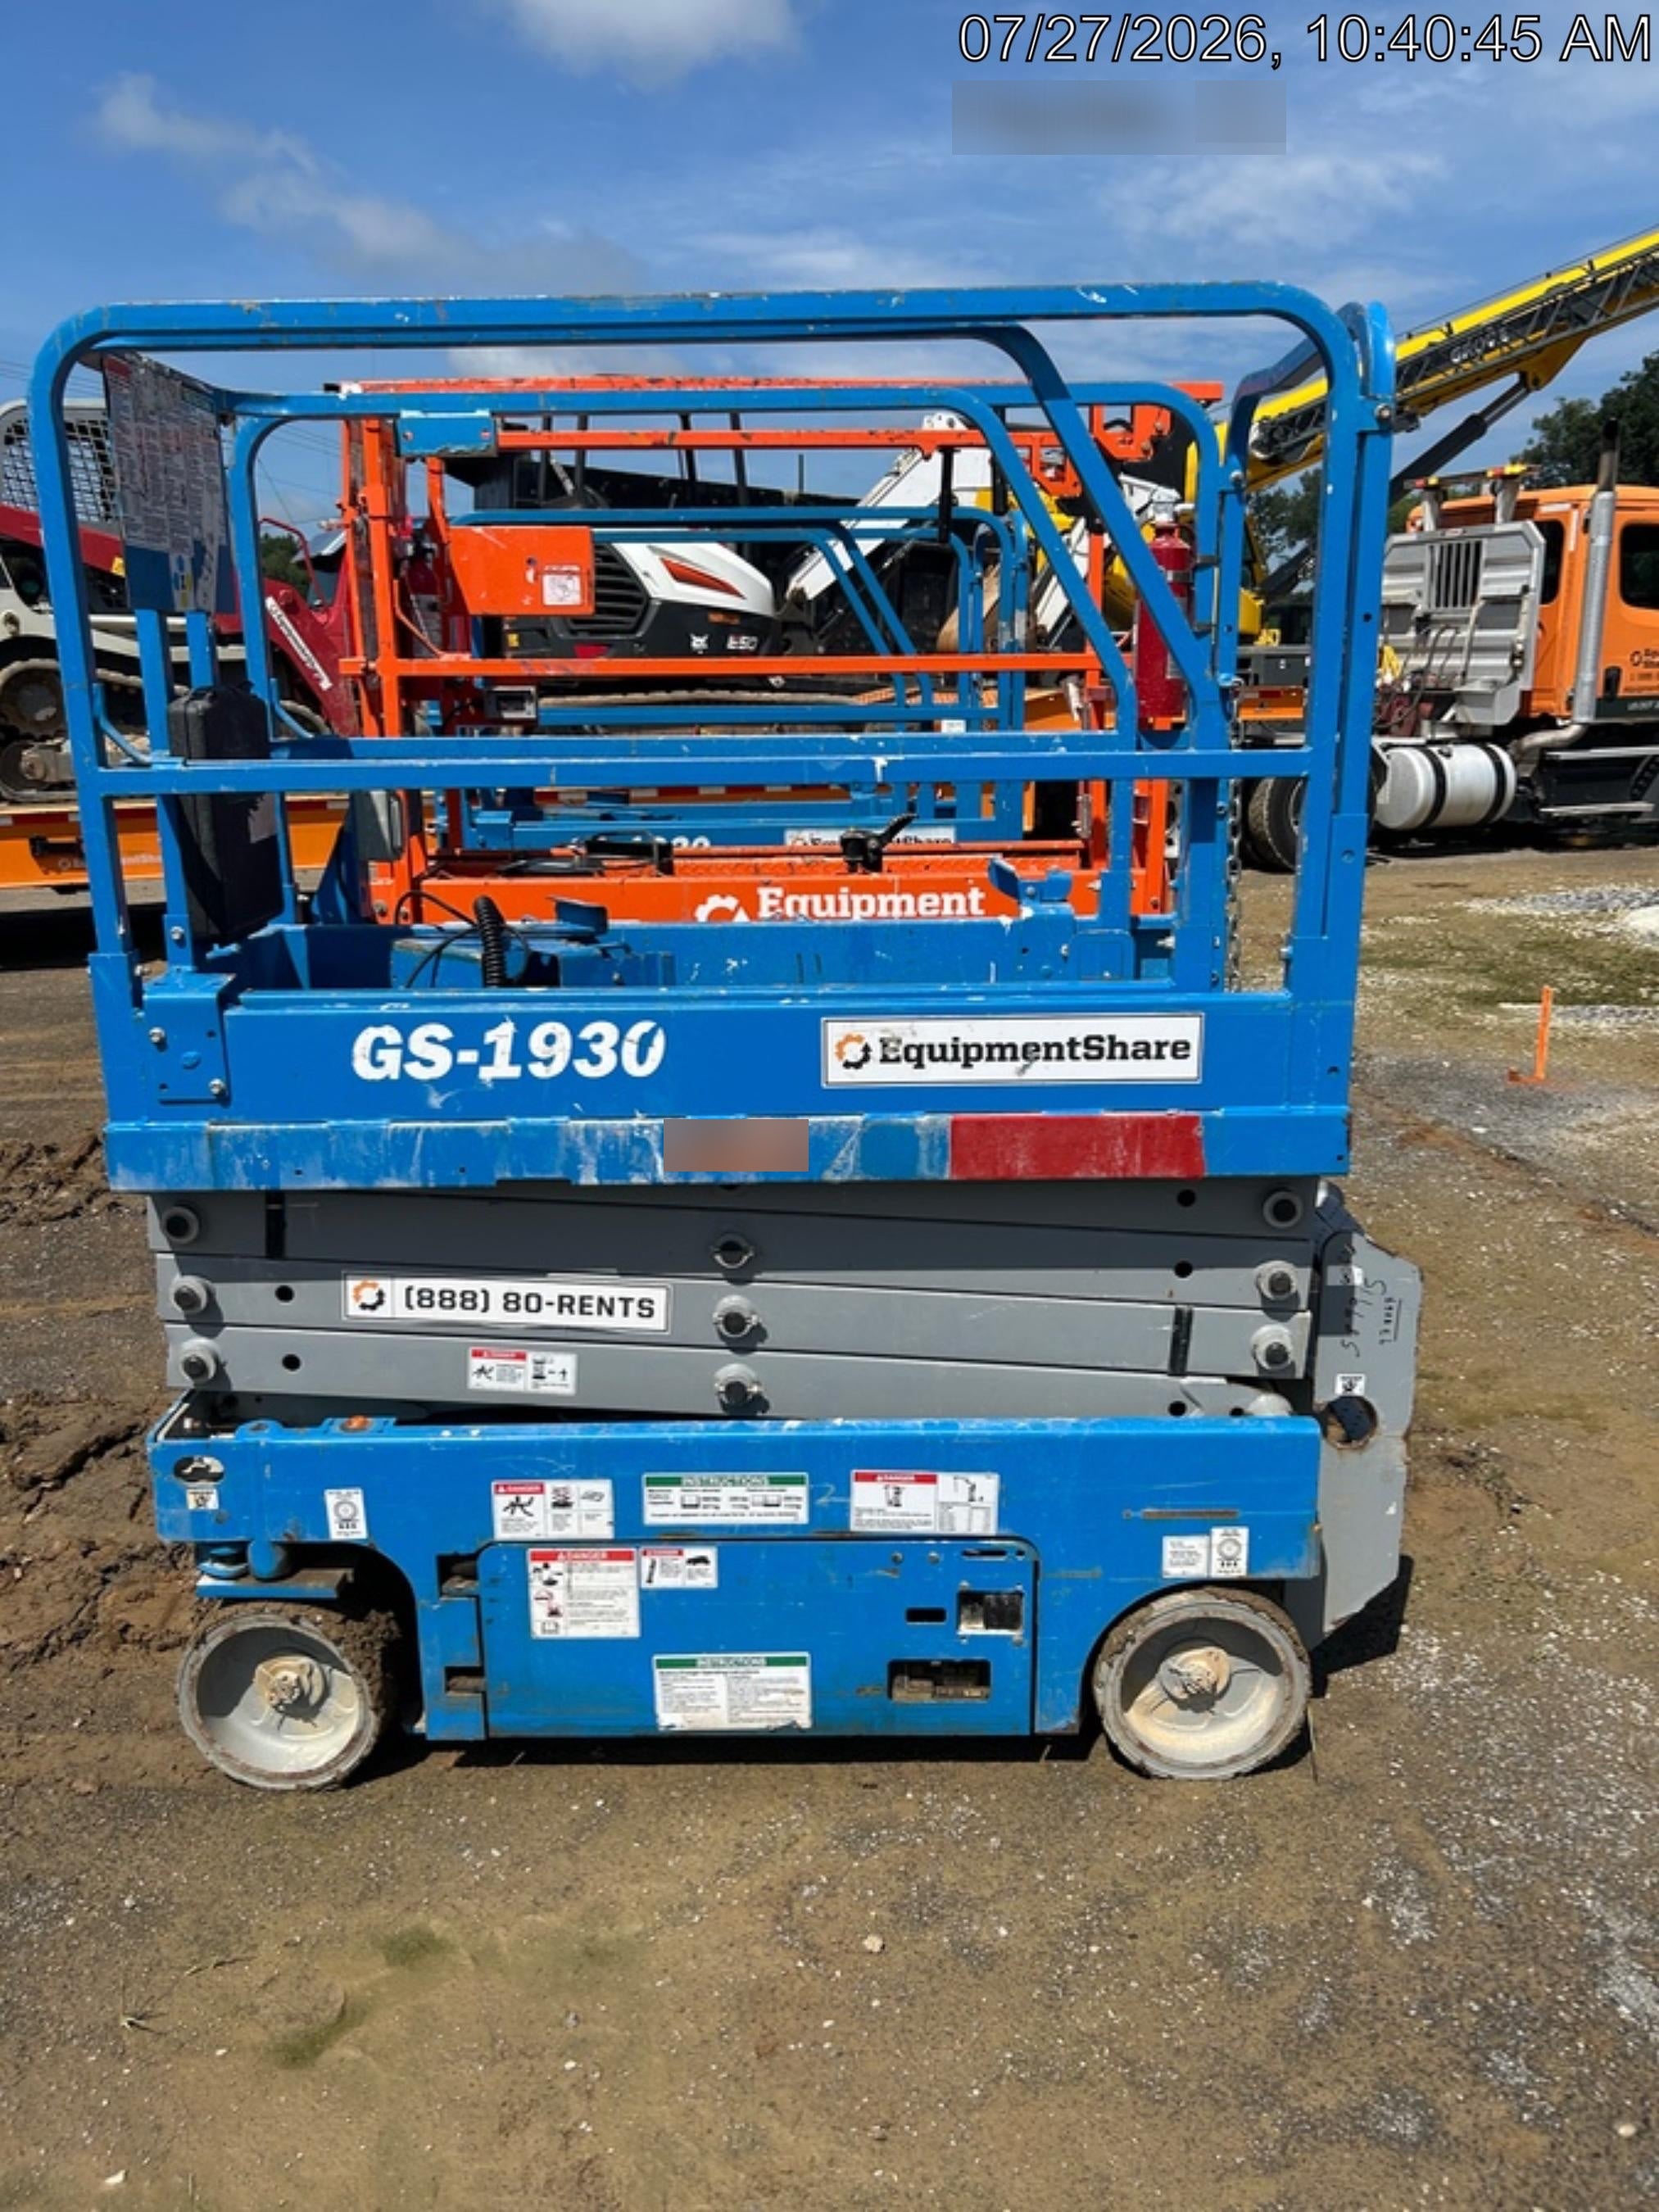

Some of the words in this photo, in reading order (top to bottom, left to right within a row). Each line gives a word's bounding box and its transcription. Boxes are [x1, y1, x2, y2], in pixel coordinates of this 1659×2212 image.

[757, 887, 986, 920] Equipment
[352, 1019, 665, 1081] GS-1930
[879, 1034, 1191, 1069] EquipmentShare
[405, 1285, 490, 1312] (888)
[503, 1291, 655, 1318] 80-RENTS
